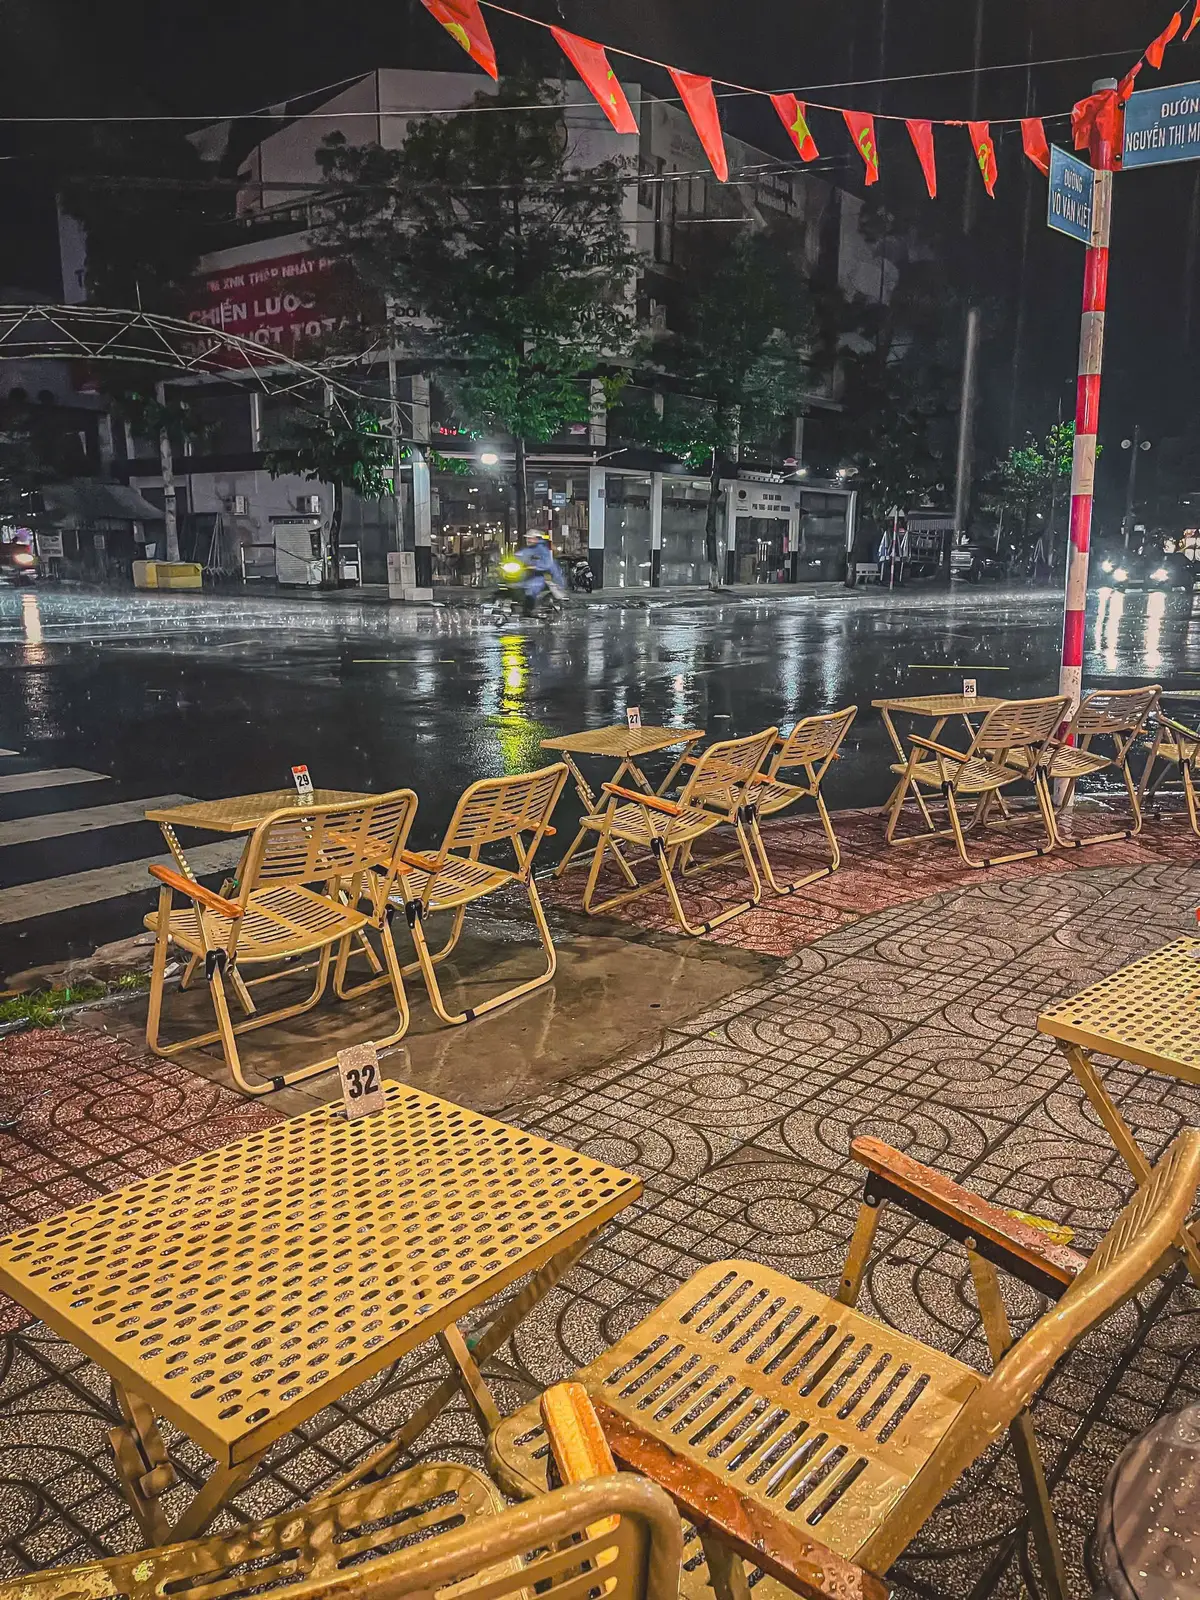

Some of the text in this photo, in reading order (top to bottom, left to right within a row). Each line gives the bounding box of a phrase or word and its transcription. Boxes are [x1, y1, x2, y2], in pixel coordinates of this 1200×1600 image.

[1125, 121, 1166, 152] NGUYỄN
[1169, 124, 1185, 149] THỊ
[1062, 193, 1076, 222] VĂN
[1076, 202, 1091, 233] KIỆT
[964, 684, 976, 693] 25
[629, 714, 639, 724] 27
[296, 774, 310, 787] 29
[346, 1064, 379, 1099] 32
